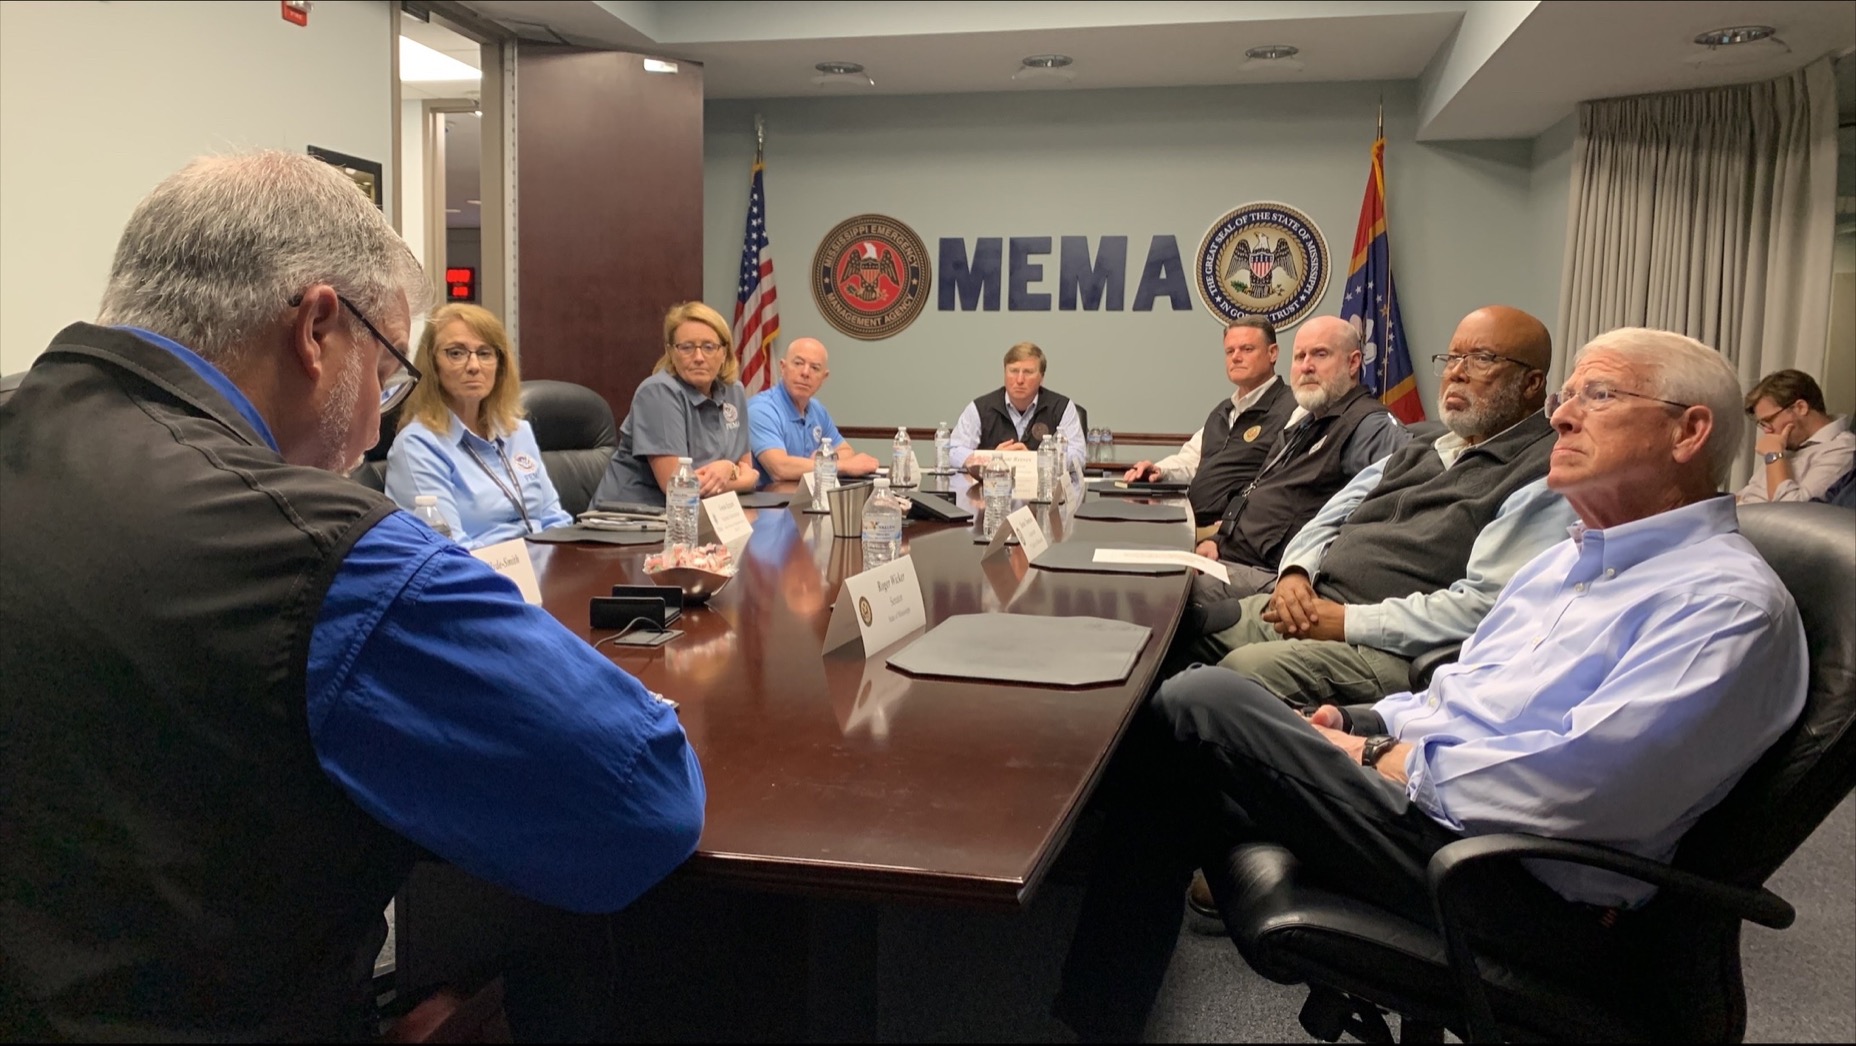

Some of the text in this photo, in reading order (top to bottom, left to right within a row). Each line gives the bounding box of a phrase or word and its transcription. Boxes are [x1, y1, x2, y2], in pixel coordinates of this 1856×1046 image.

[824, 225, 918, 267] MISSISSIPPI EMERGENCY
[1205, 211, 1319, 296] THE GREAT SEAL OF THE STATE OF MISSISSIPPI
[938, 234, 1192, 312] MEMA
[826, 292, 914, 327] MANAGEMENT AGENCY
[1219, 300, 1231, 312] IN
[1270, 300, 1300, 321] TRUST
[876, 572, 905, 593] Roger Wicker
